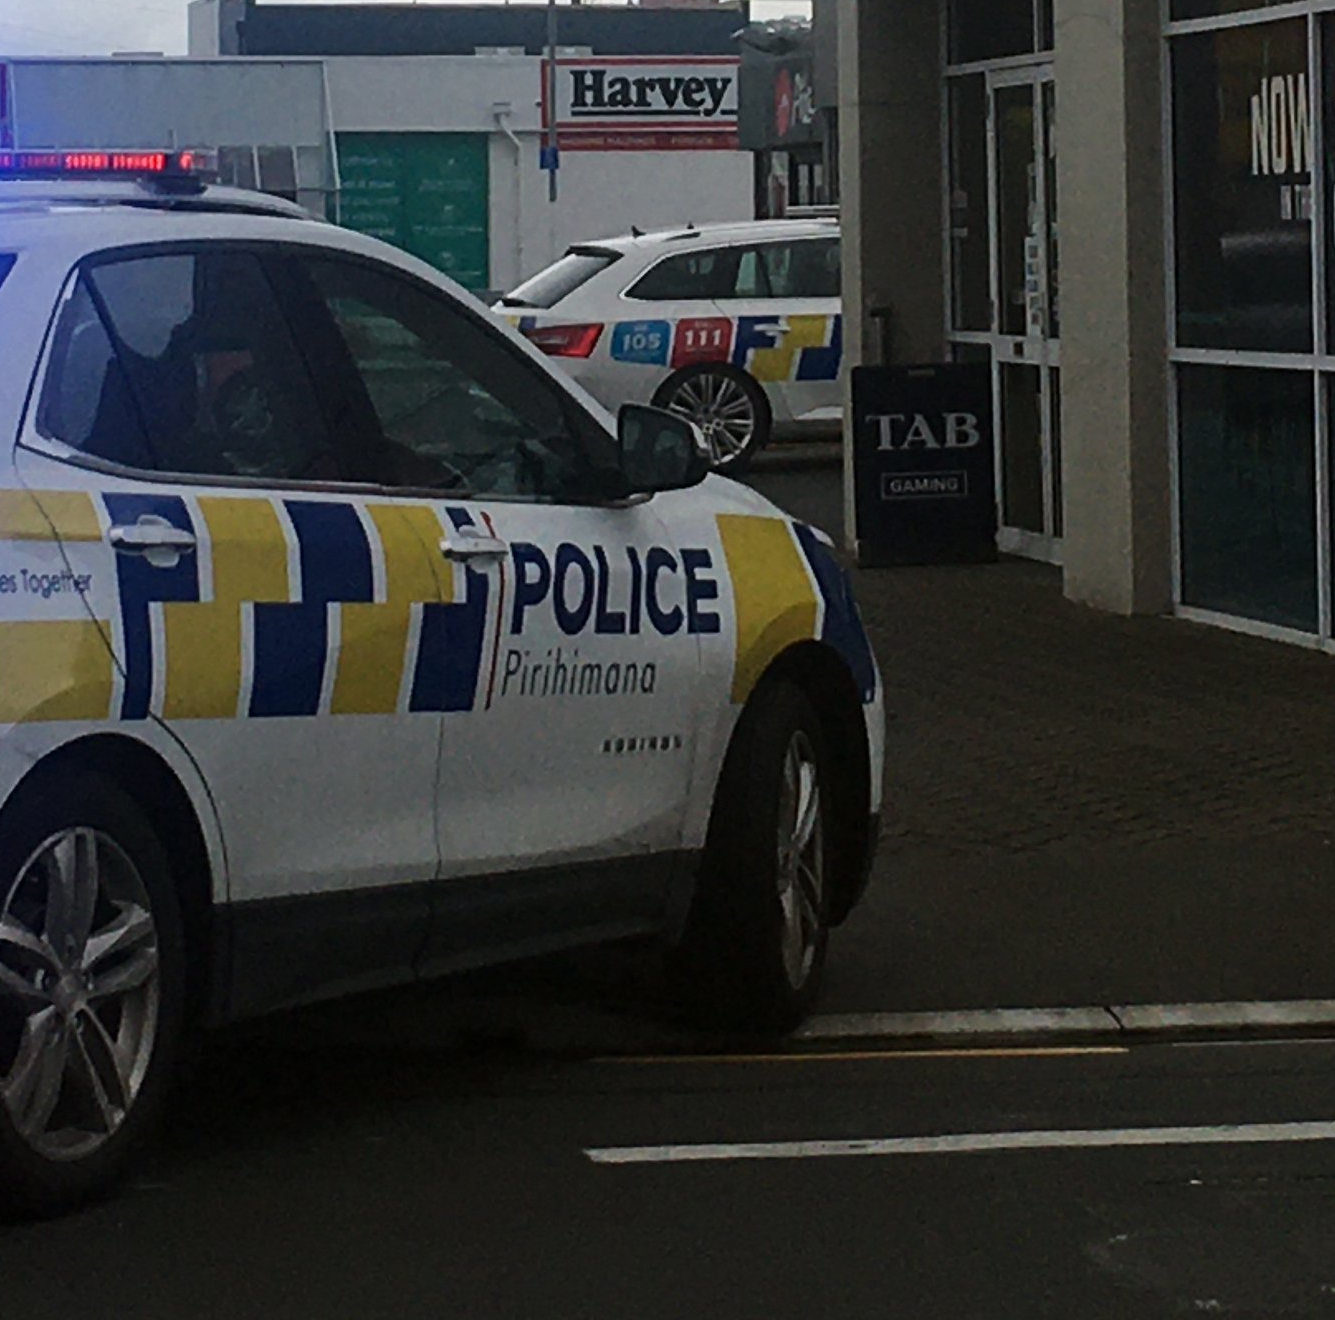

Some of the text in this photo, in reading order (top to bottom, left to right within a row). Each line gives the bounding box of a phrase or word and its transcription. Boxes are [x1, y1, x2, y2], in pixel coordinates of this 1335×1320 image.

[569, 68, 733, 118] Harvey
[1250, 72, 1313, 176] NOW
[621, 332, 662, 352] 105
[684, 328, 722, 347] 111
[864, 411, 981, 451] TAB
[889, 477, 959, 493] GAMING
[19, 567, 93, 600] Together
[509, 541, 721, 636] POLICE
[500, 647, 657, 697] Pirihimana
